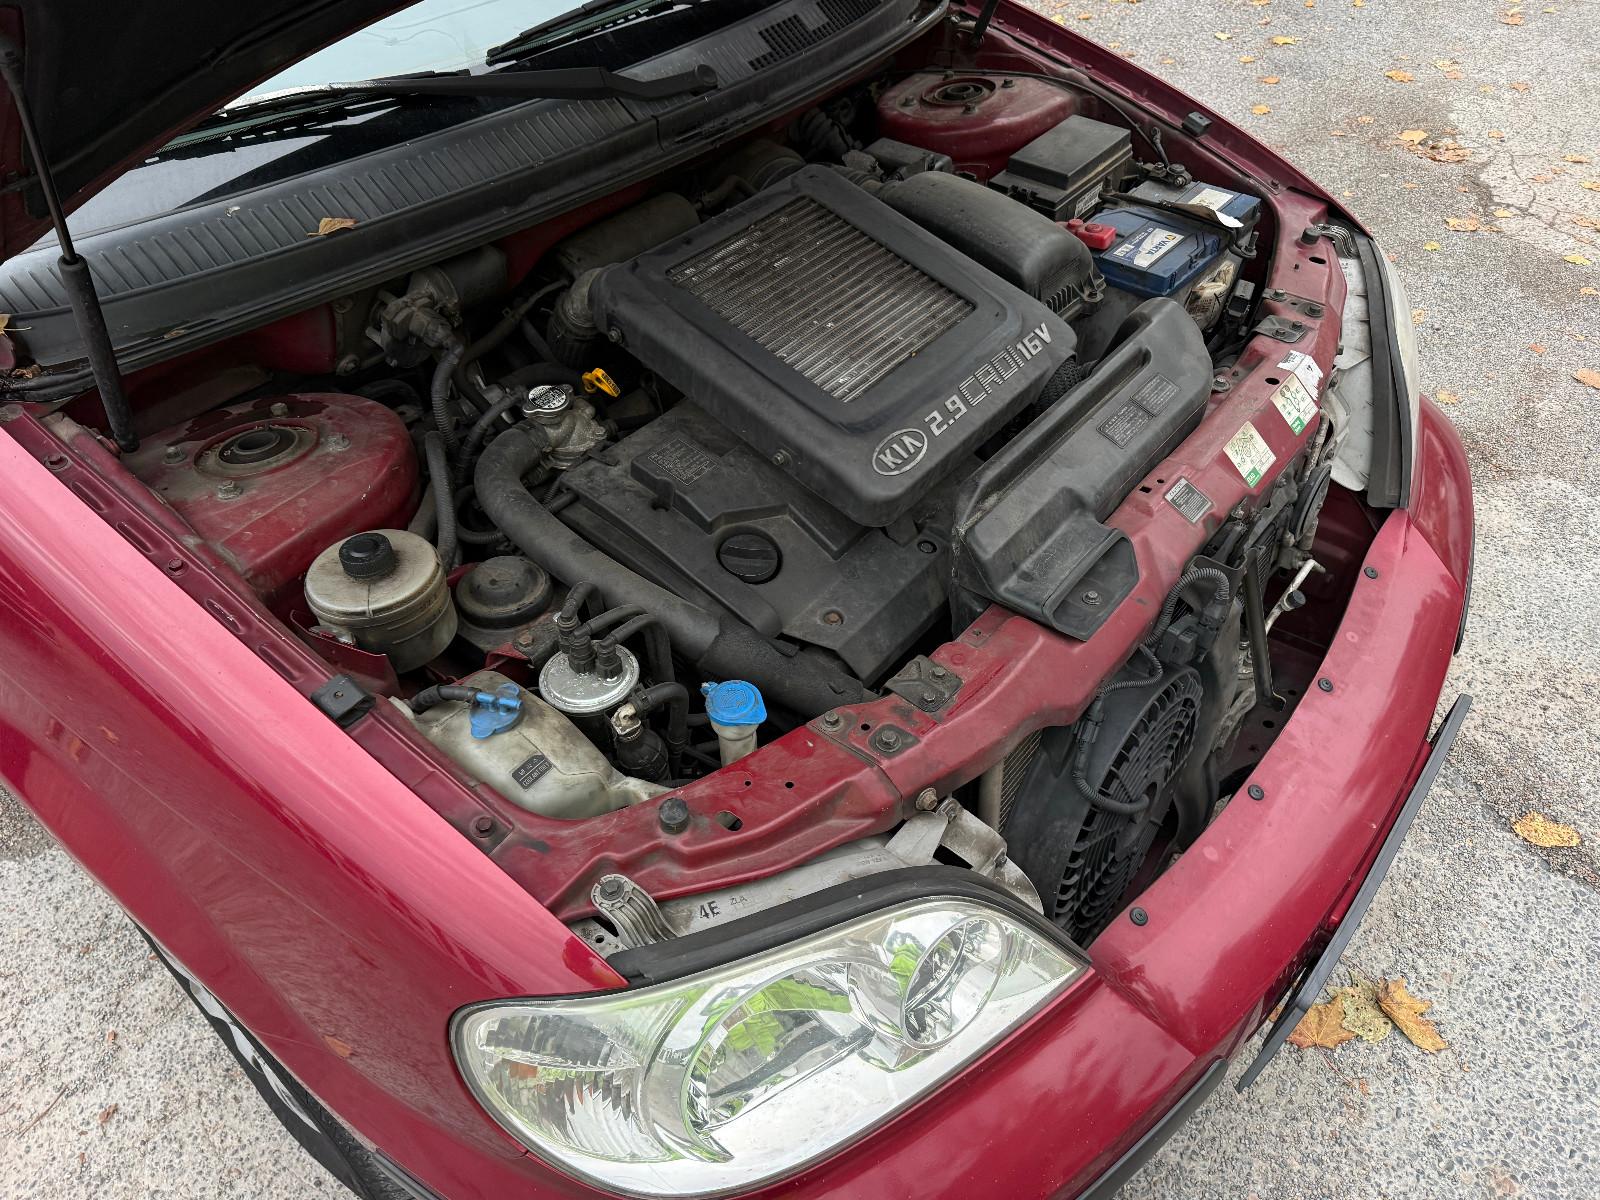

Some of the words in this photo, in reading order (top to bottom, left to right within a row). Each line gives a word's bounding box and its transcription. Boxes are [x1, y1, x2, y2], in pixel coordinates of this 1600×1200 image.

[1145, 240, 1170, 255] VARTA
[924, 394, 968, 437] 2.9
[878, 435, 922, 469] KIA
[699, 900, 721, 919] 4E
